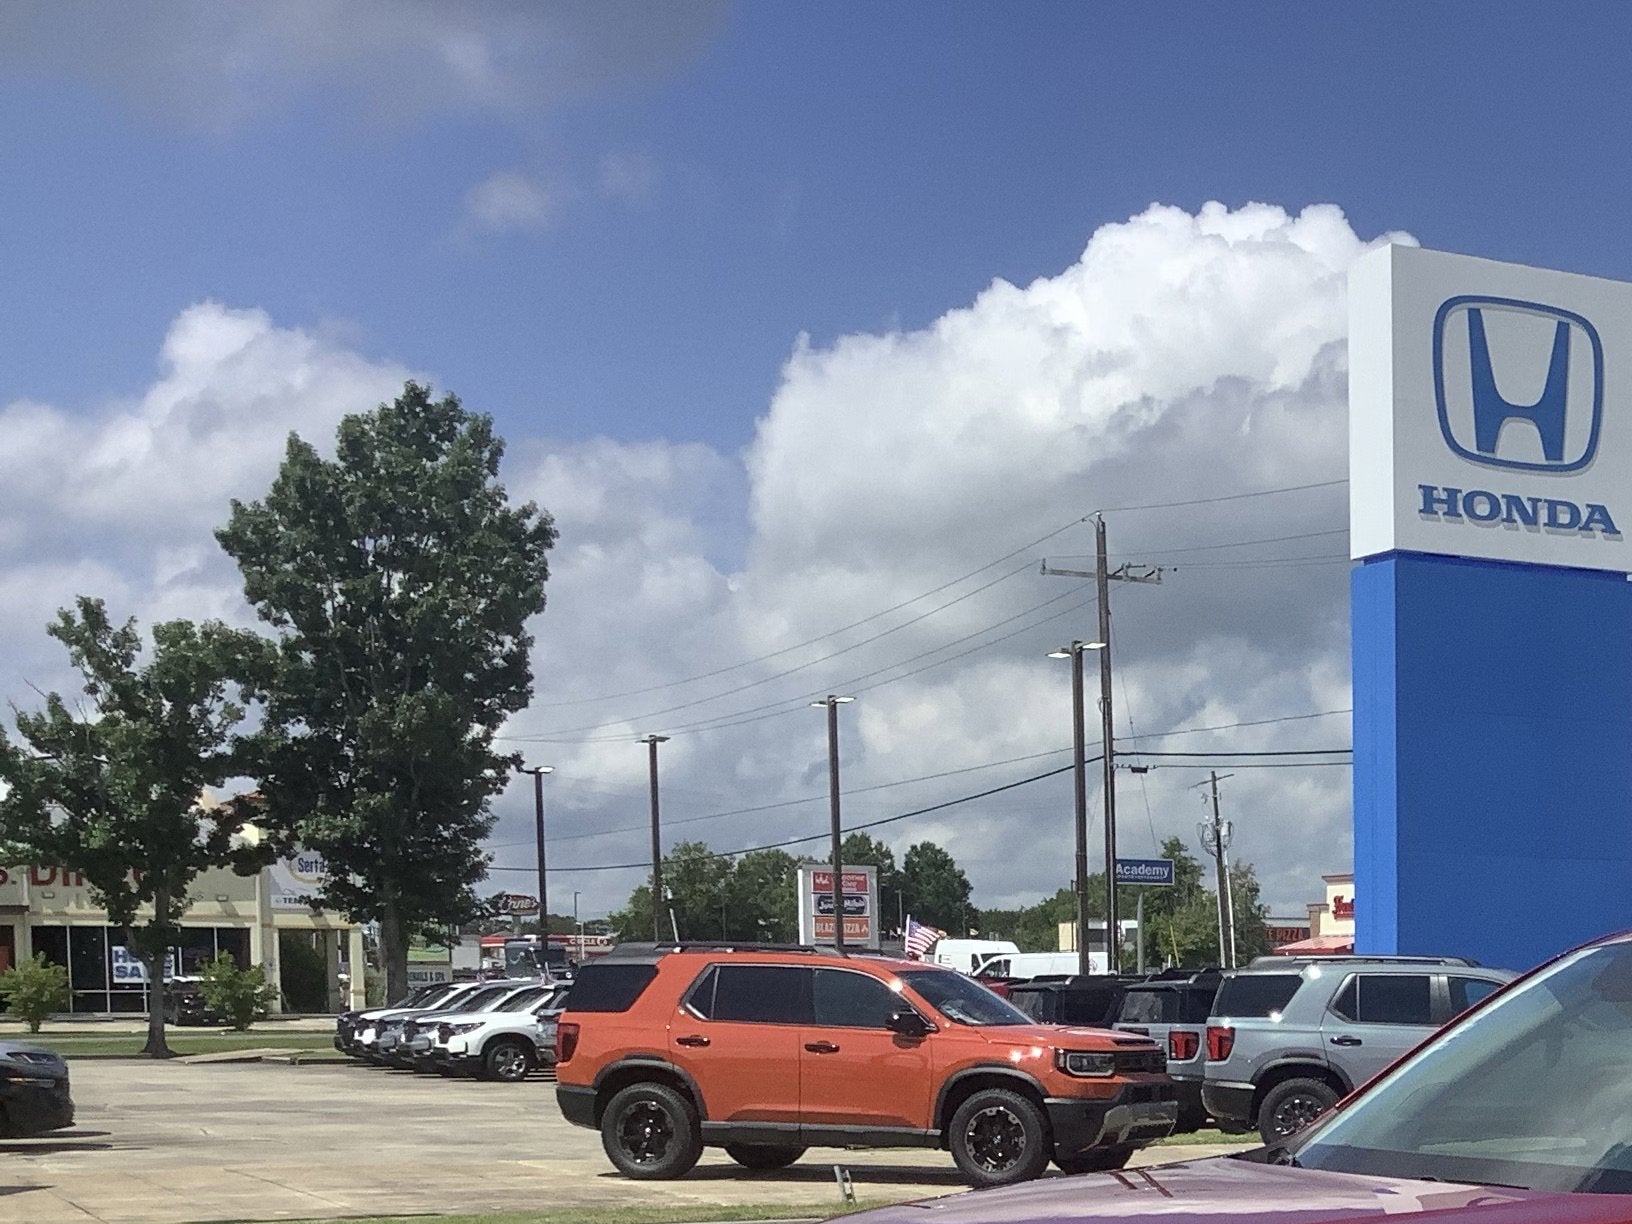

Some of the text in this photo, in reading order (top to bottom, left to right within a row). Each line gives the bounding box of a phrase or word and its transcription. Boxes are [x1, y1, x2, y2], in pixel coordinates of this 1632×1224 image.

[1417, 484, 1622, 535] HONDA
[297, 857, 325, 873] Serta
[1115, 863, 1170, 879] Academy
